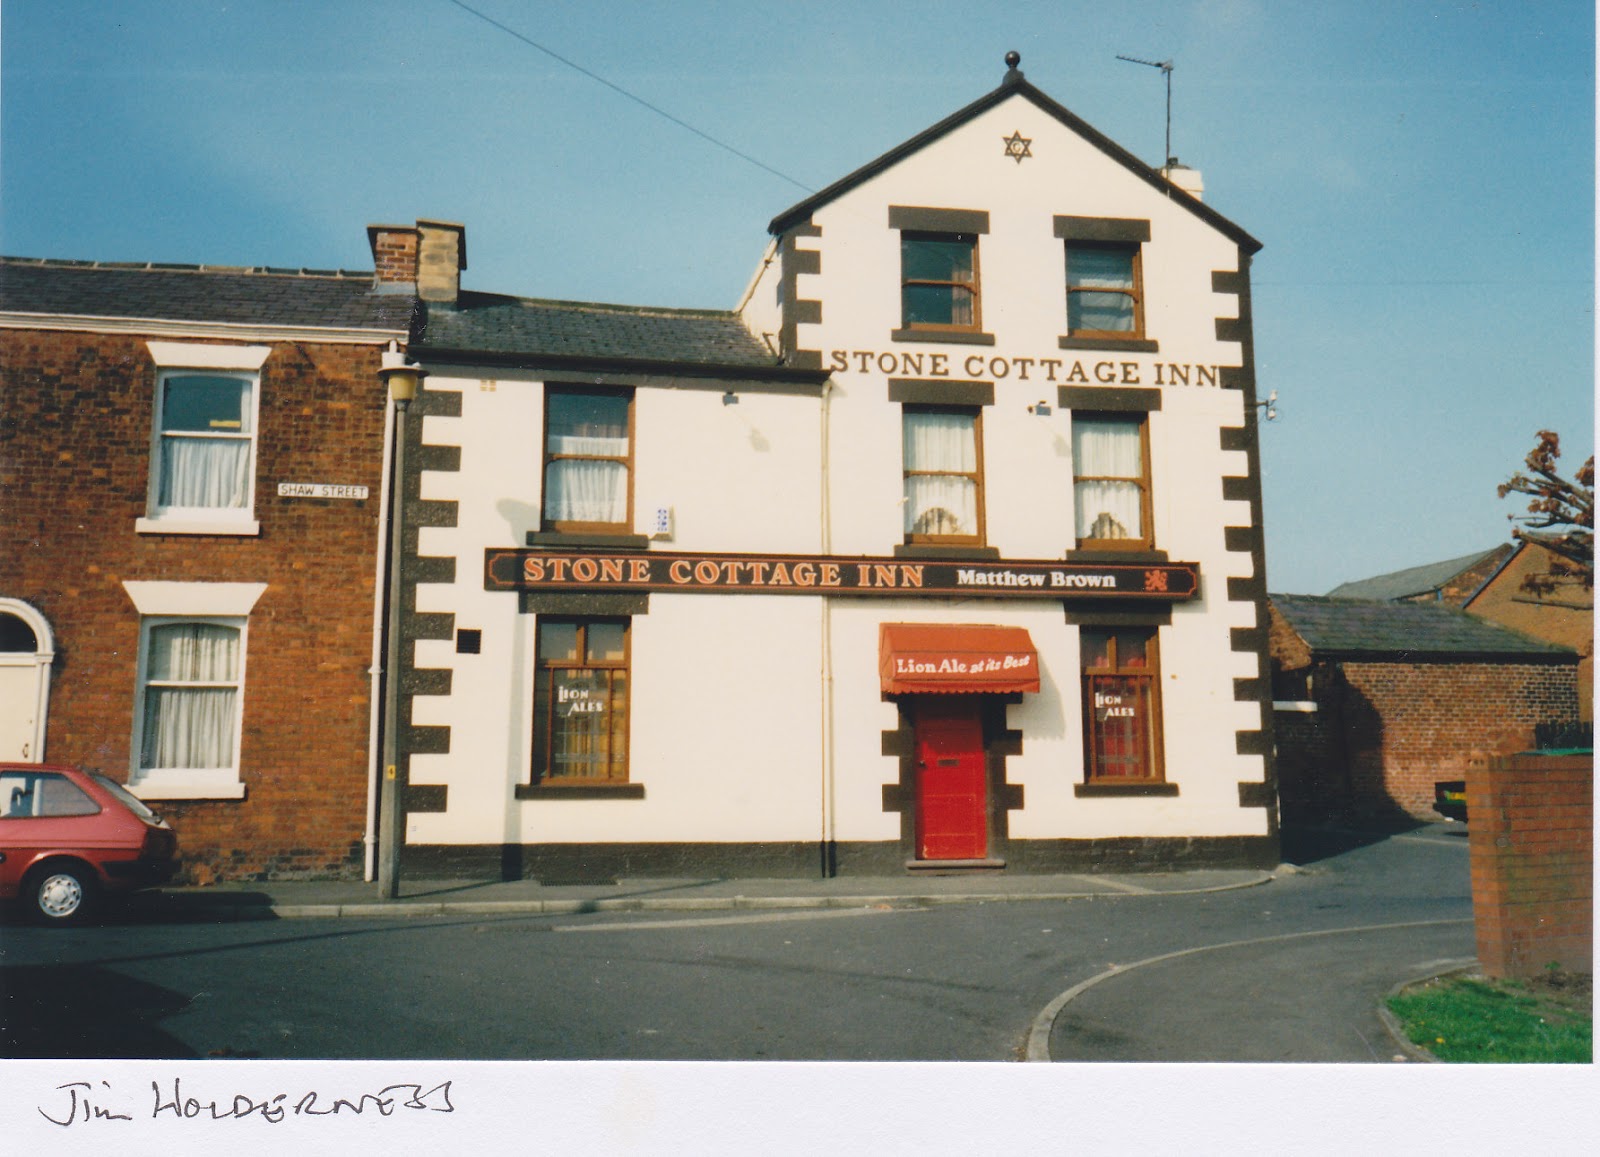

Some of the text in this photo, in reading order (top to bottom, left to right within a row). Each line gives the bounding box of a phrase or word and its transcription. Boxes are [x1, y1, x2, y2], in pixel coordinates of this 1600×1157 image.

[831, 351, 1220, 387] STONE COTTAGE INN
[281, 484, 365, 497] SHAW STREET
[523, 557, 925, 588] STONE COTTAGE INN
[957, 567, 1116, 588] Matthew Brown
[897, 655, 1031, 674] Lion Ale at its Best
[567, 701, 604, 717] ALES
[1103, 706, 1135, 721] ALES
[38, 1081, 132, 1126] Jim
